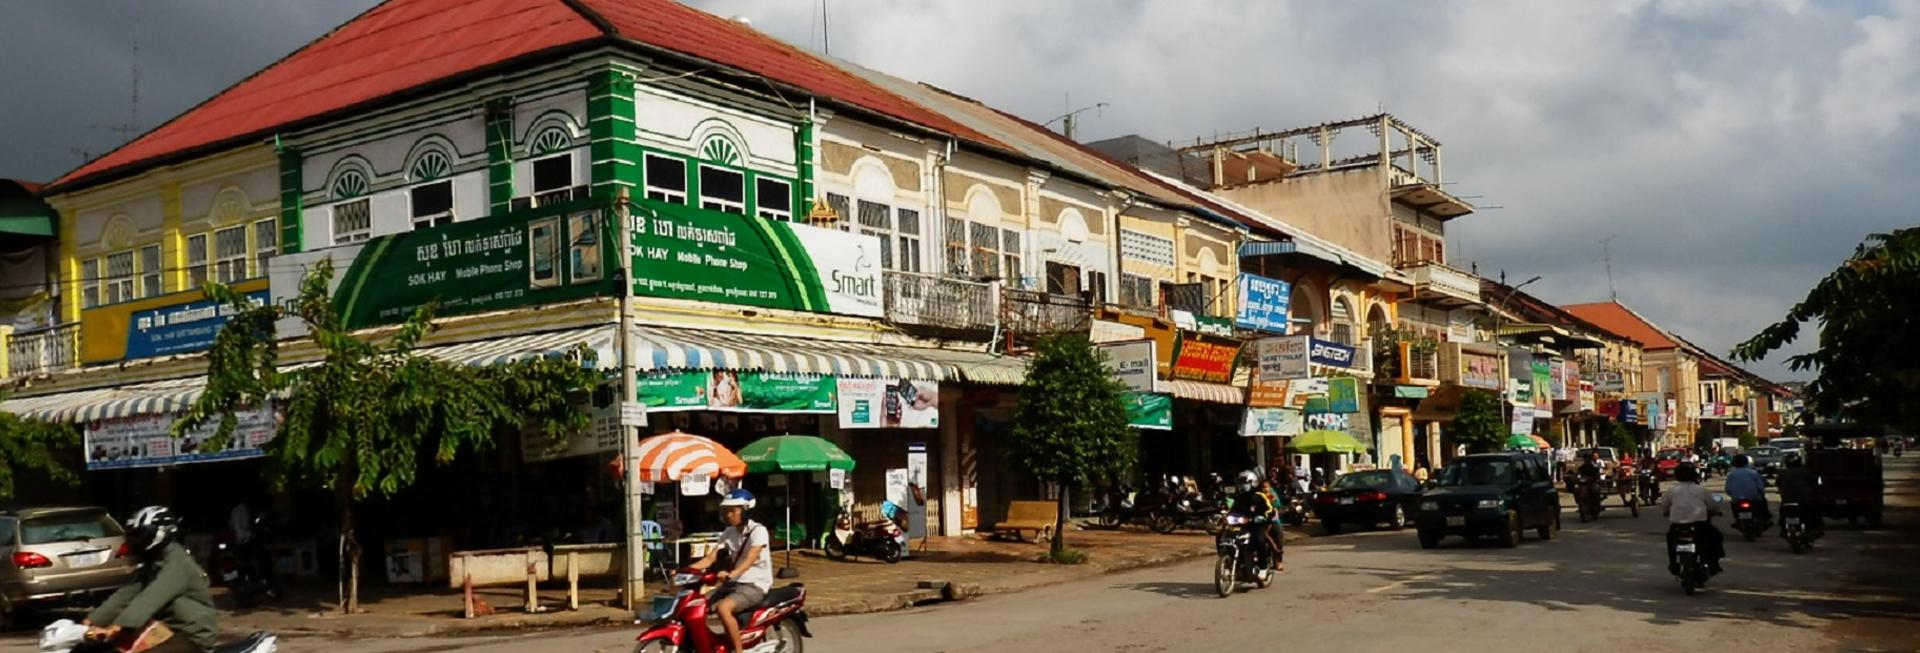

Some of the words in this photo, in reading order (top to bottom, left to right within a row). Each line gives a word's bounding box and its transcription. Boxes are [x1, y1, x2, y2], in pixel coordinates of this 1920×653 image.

[629, 244, 645, 258] OK
[647, 246, 669, 260] HAY
[677, 251, 702, 265] Mobile
[705, 254, 728, 268] Phone
[729, 258, 748, 272] Shop
[408, 275, 426, 287] SOK
[427, 270, 446, 284] HAY
[456, 265, 479, 279] Mobile
[480, 263, 502, 275] Phone
[504, 260, 523, 272] Shop
[831, 269, 876, 298] Smart
